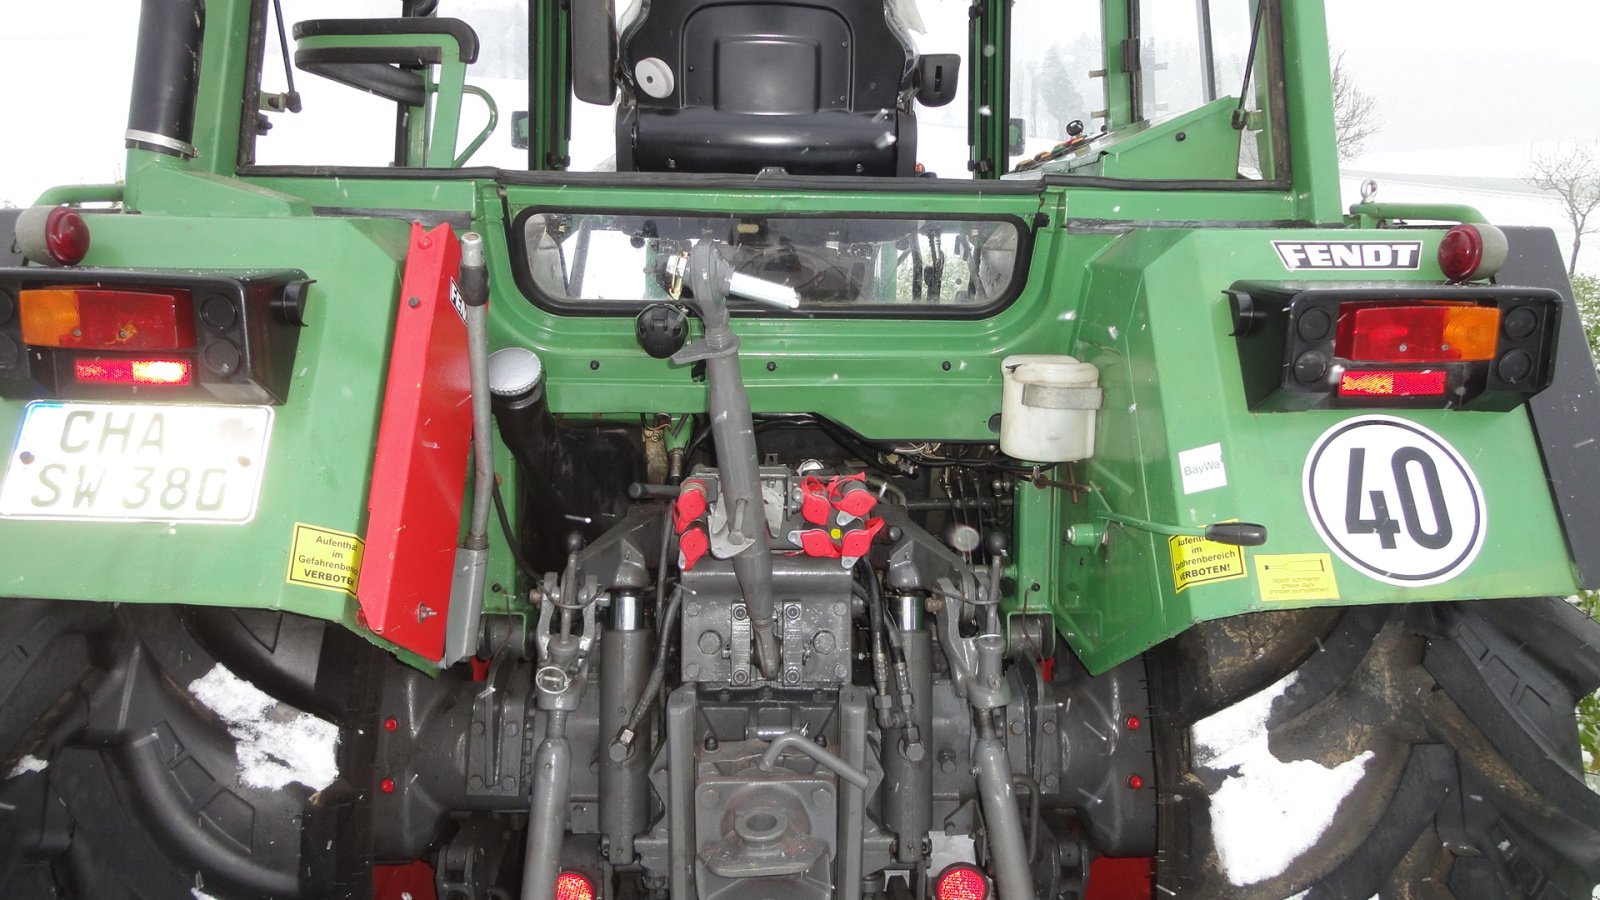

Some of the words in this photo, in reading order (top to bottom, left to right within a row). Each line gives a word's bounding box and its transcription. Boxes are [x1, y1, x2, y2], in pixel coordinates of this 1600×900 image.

[1276, 244, 1418, 267] FENDT
[60, 410, 165, 454] CHA
[1184, 460, 1221, 477] BayWa
[30, 463, 106, 508] SW
[121, 466, 227, 511] 380
[1345, 446, 1453, 550] 40
[332, 550, 343, 559] im
[1191, 546, 1203, 554] im
